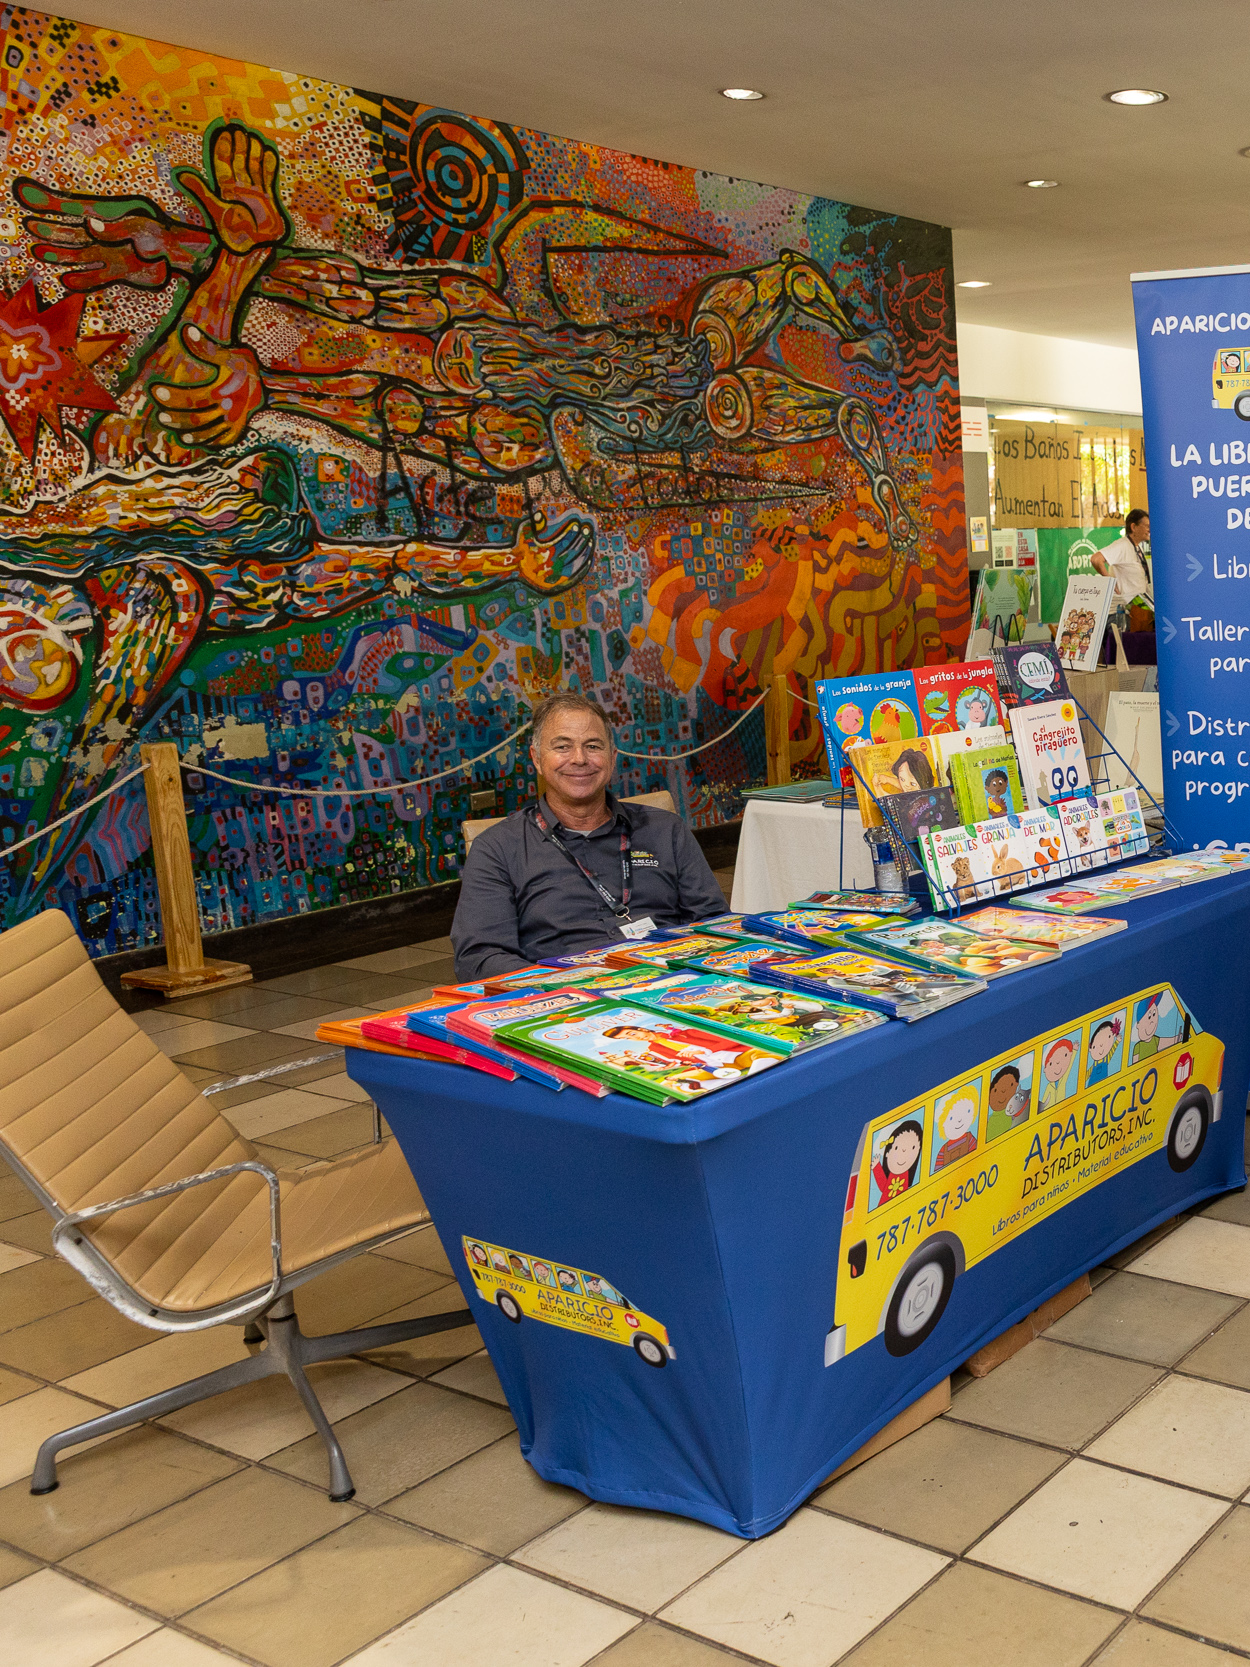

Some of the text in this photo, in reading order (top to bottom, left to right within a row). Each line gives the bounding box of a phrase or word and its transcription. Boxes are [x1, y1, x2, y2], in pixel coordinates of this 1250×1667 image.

[1025, 425, 1069, 460] Baños
[1170, 444, 1202, 467] LA
[995, 478, 1064, 518] Aumentan
[930, 672, 955, 685] gritos
[968, 666, 993, 680] jungla
[1019, 658, 1053, 678] CEMÍ,
[842, 683, 872, 694] sonidos
[886, 679, 911, 691] granja
[1033, 726, 1075, 742] Cangrejito
[1035, 736, 1077, 756] piragüero
[1172, 749, 1225, 769] para
[1063, 810, 1098, 826] ADORABLES
[1068, 804, 1088, 813] ANIMALES
[983, 822, 1004, 832] ANIMALES
[1024, 816, 1046, 826] ANIMALES
[1024, 822, 1055, 837] DEL MAR
[943, 833, 966, 844] ANIMALES
[982, 828, 1016, 844] GRANJA
[938, 838, 978, 858] SALVAJES
[543, 1010, 642, 1041] GULLIVER
[1023, 1067, 1159, 1172] APARICIO
[992, 1132, 1154, 1236] Libros para niños Material educativo
[537, 1289, 614, 1321] APARICIO
